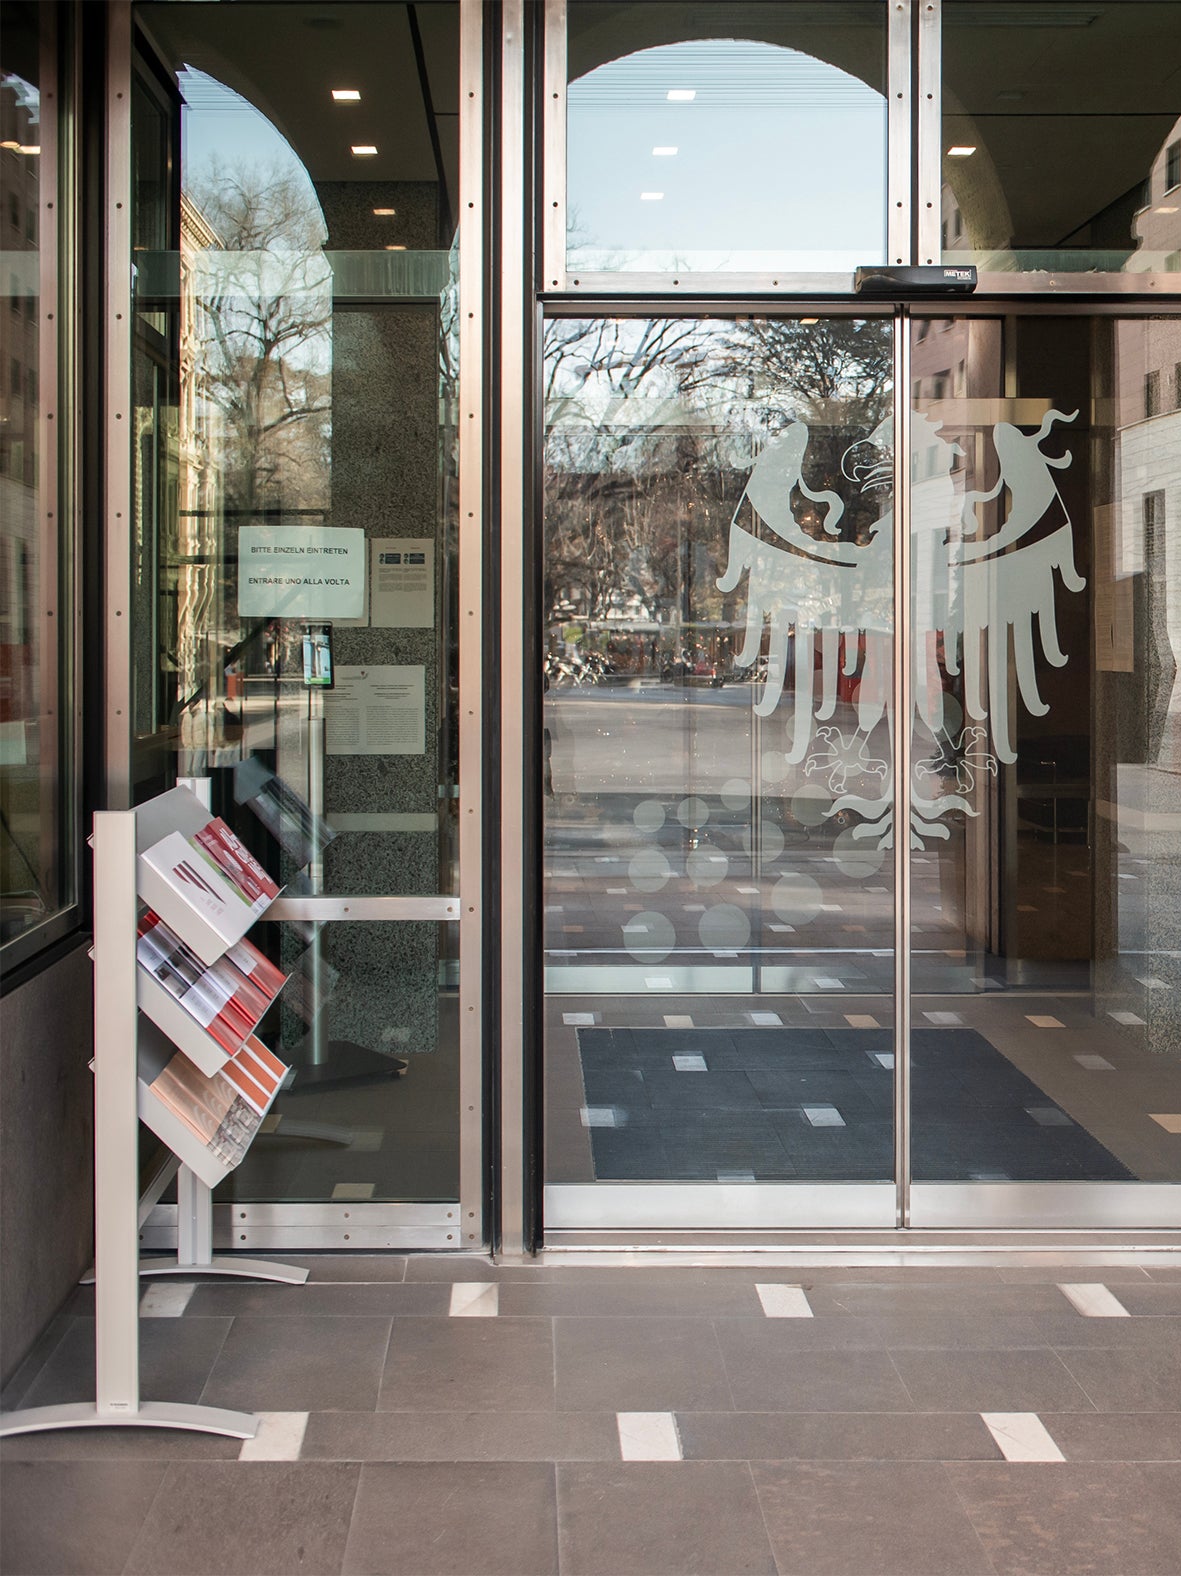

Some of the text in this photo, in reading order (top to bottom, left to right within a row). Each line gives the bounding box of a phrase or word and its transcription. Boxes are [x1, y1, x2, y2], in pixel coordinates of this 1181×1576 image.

[251, 546, 348, 555] BITTE EINZELN EINTRETEN
[248, 577, 284, 585] ENTRARE
[285, 577, 302, 585] UNO
[324, 578, 350, 586] VOLTA
